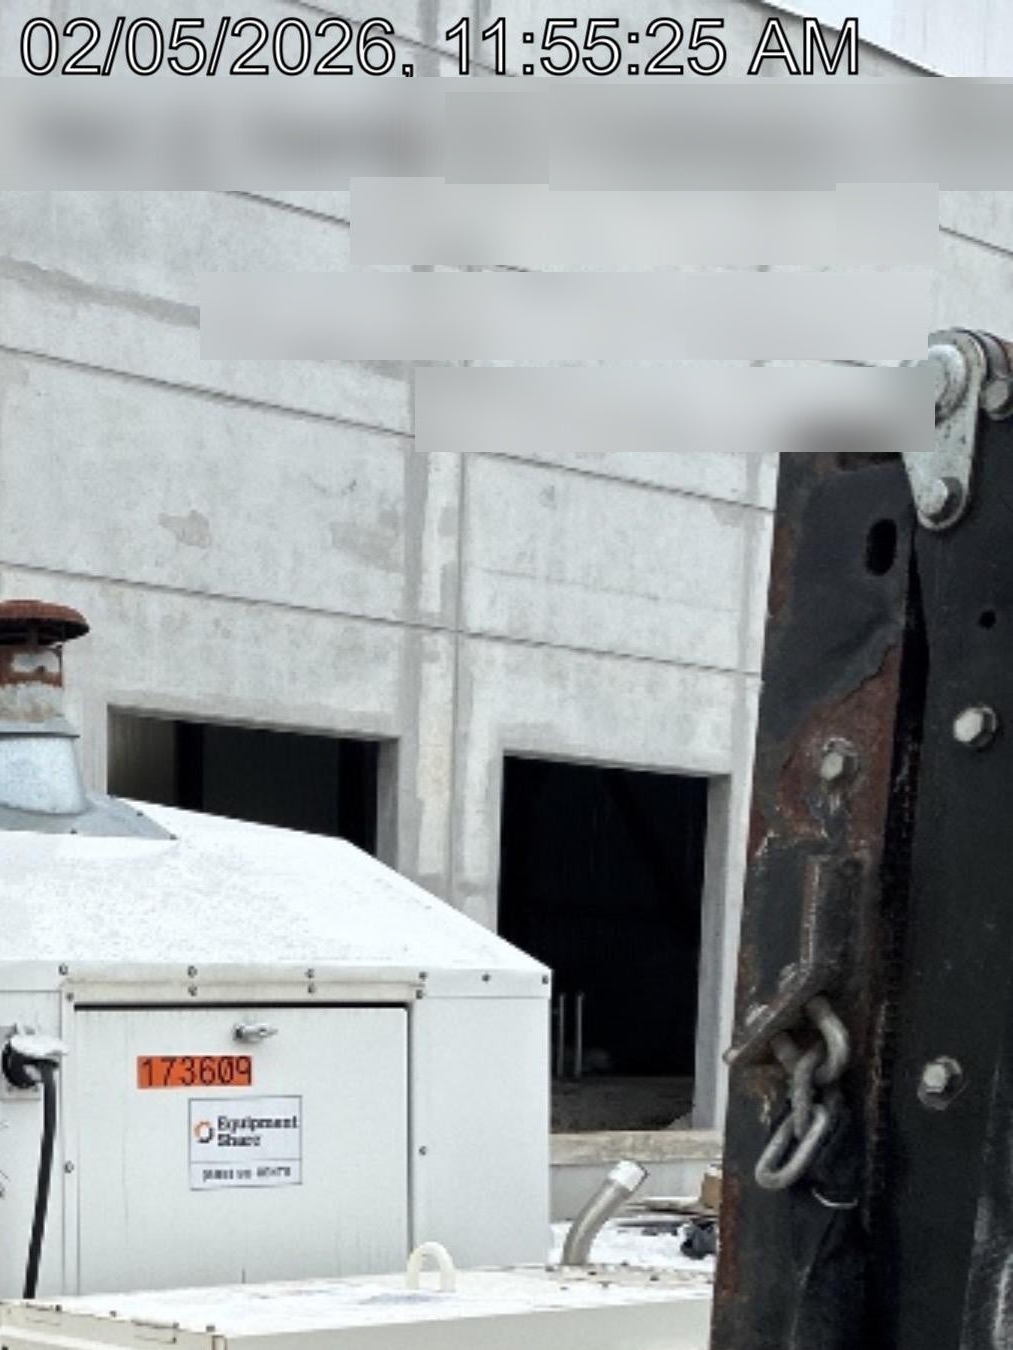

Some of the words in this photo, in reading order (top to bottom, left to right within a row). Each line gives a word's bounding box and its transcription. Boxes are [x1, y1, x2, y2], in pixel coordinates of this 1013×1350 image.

[140, 1056, 252, 1087] 173609
[217, 1116, 298, 1134] Equipment
[217, 1134, 261, 1147] Share
